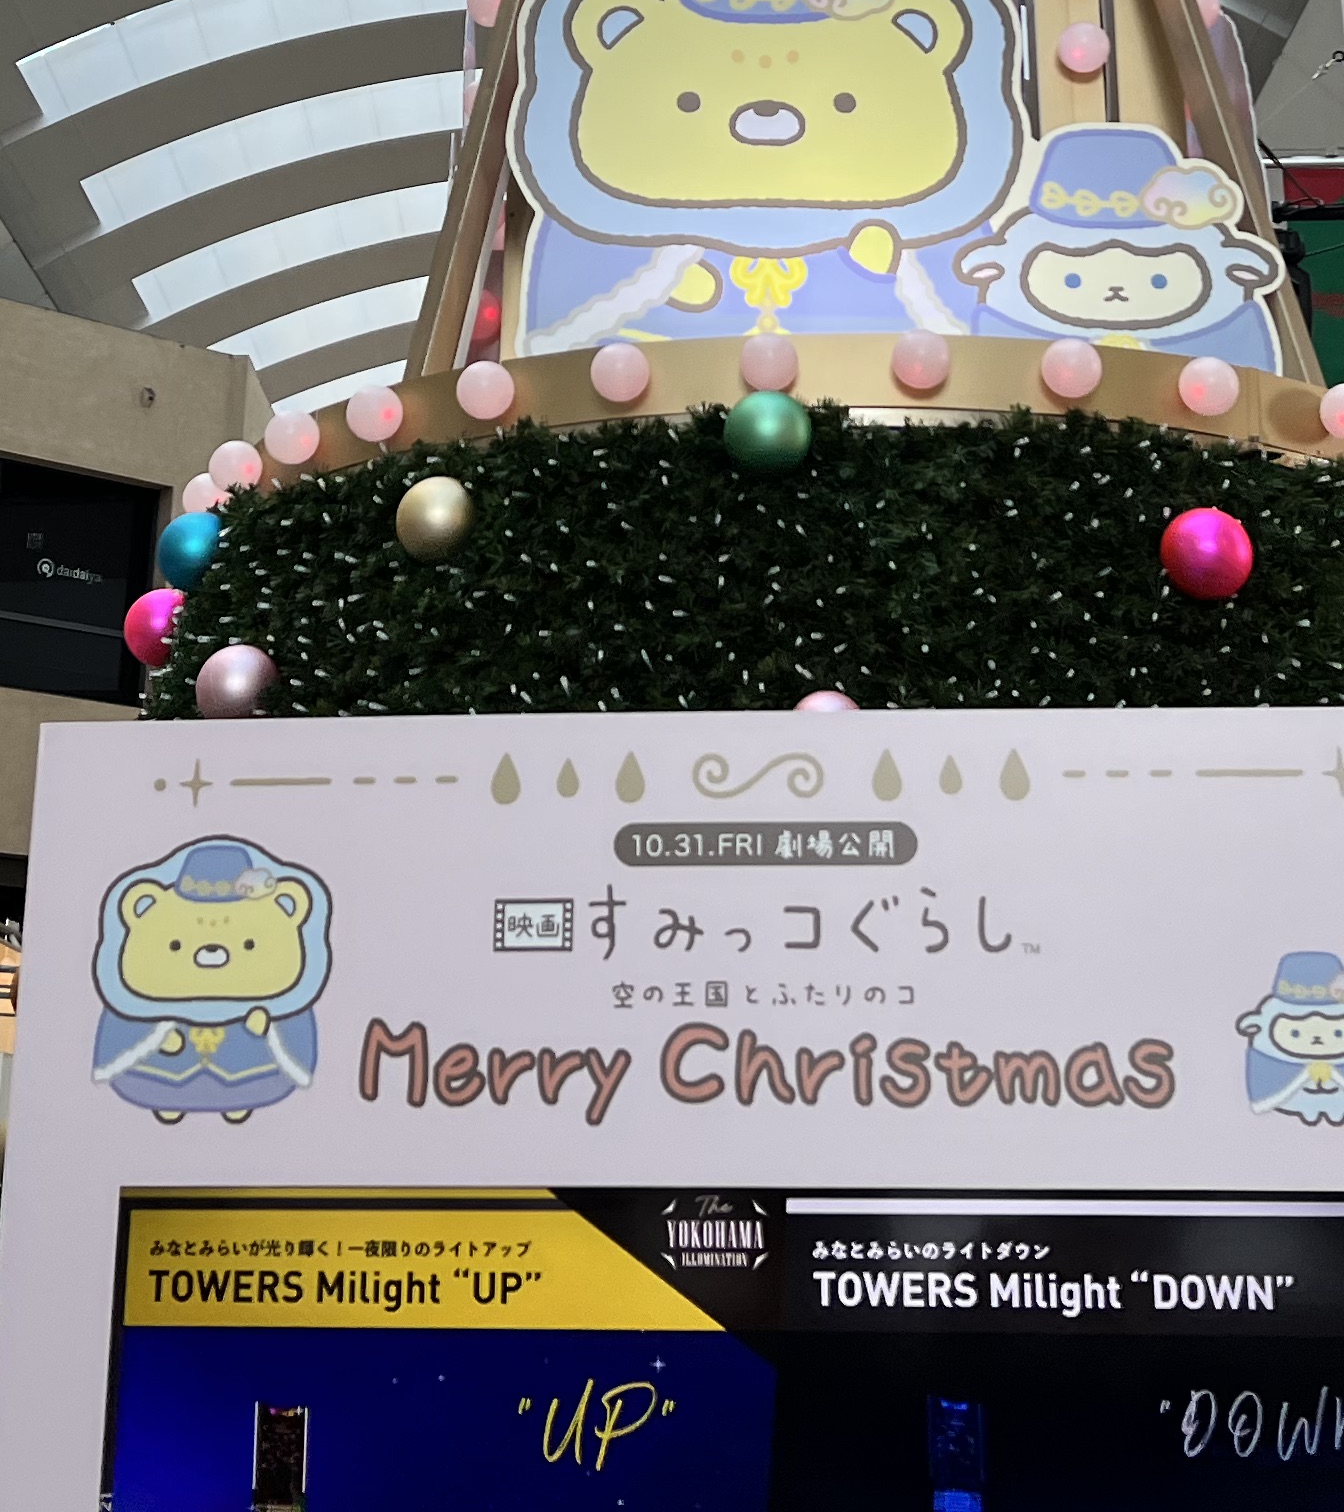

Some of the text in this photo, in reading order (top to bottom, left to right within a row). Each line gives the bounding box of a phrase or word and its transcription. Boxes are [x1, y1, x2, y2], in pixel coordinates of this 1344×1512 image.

[630, 832, 896, 859] 10.31.FRI 劇場公開
[507, 911, 561, 939] 映画
[588, 884, 1013, 961] すみっコぐらし
[611, 980, 916, 1009] 空の王国とふたりのコ
[358, 1017, 1176, 1126] Merry Christmas
[694, 1194, 734, 1218] The
[666, 1219, 765, 1249] YOKOHAMA
[681, 1252, 748, 1267] ILLUMINATION
[812, 1240, 1051, 1260] みなとみらいのライトダウン
[149, 1270, 303, 1304] TOWERS
[316, 1269, 440, 1313] Milight
[812, 1270, 978, 1308] TOWERS
[989, 1271, 1122, 1319] Milight
